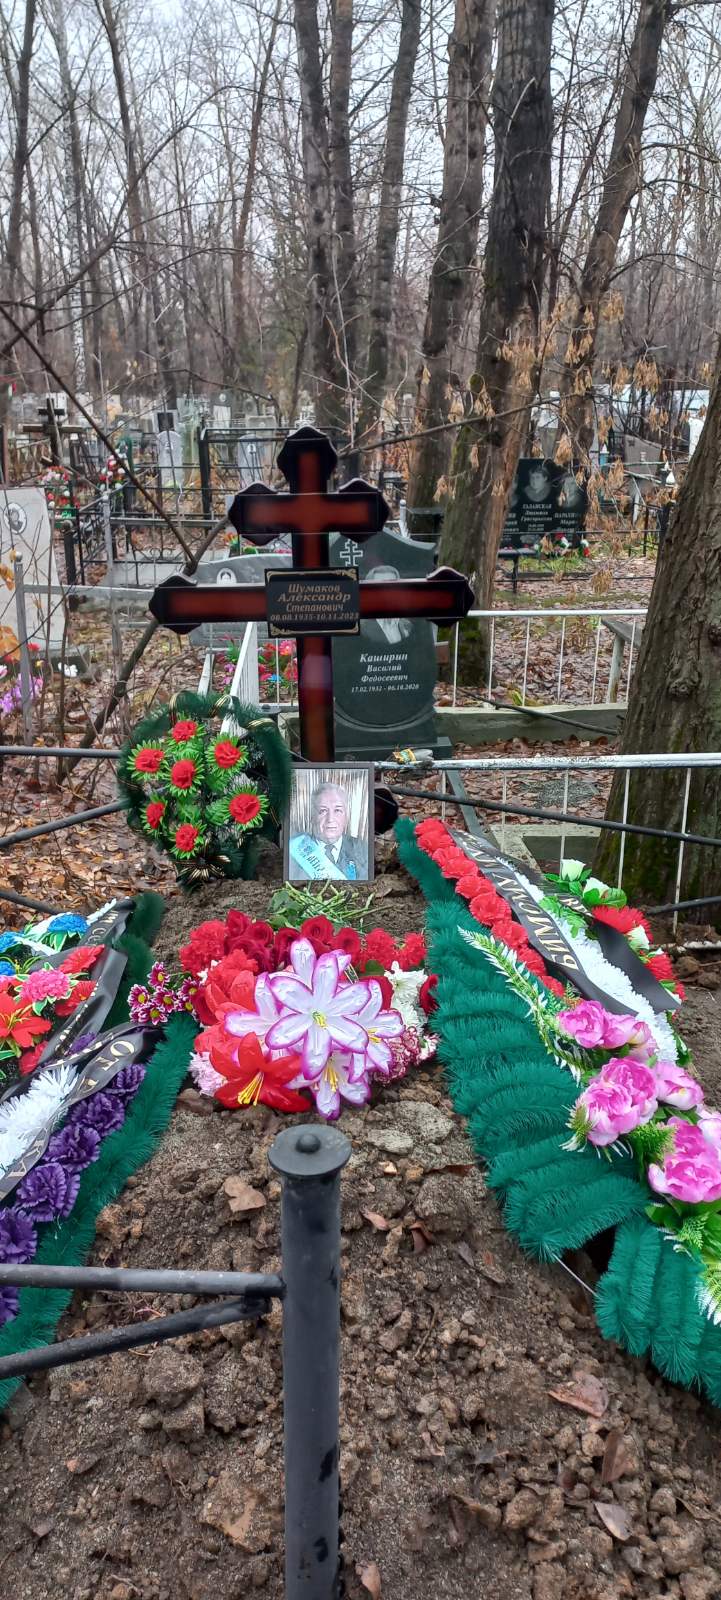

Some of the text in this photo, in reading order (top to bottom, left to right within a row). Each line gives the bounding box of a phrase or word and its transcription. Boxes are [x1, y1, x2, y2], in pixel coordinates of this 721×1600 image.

[287, 583, 341, 594] Шумаков
[277, 592, 351, 603] Александр
[286, 602, 344, 613] Степанович
[359, 653, 408, 664] Каширин
[366, 664, 402, 673] Василий
[361, 674, 408, 683] Федосеевич
